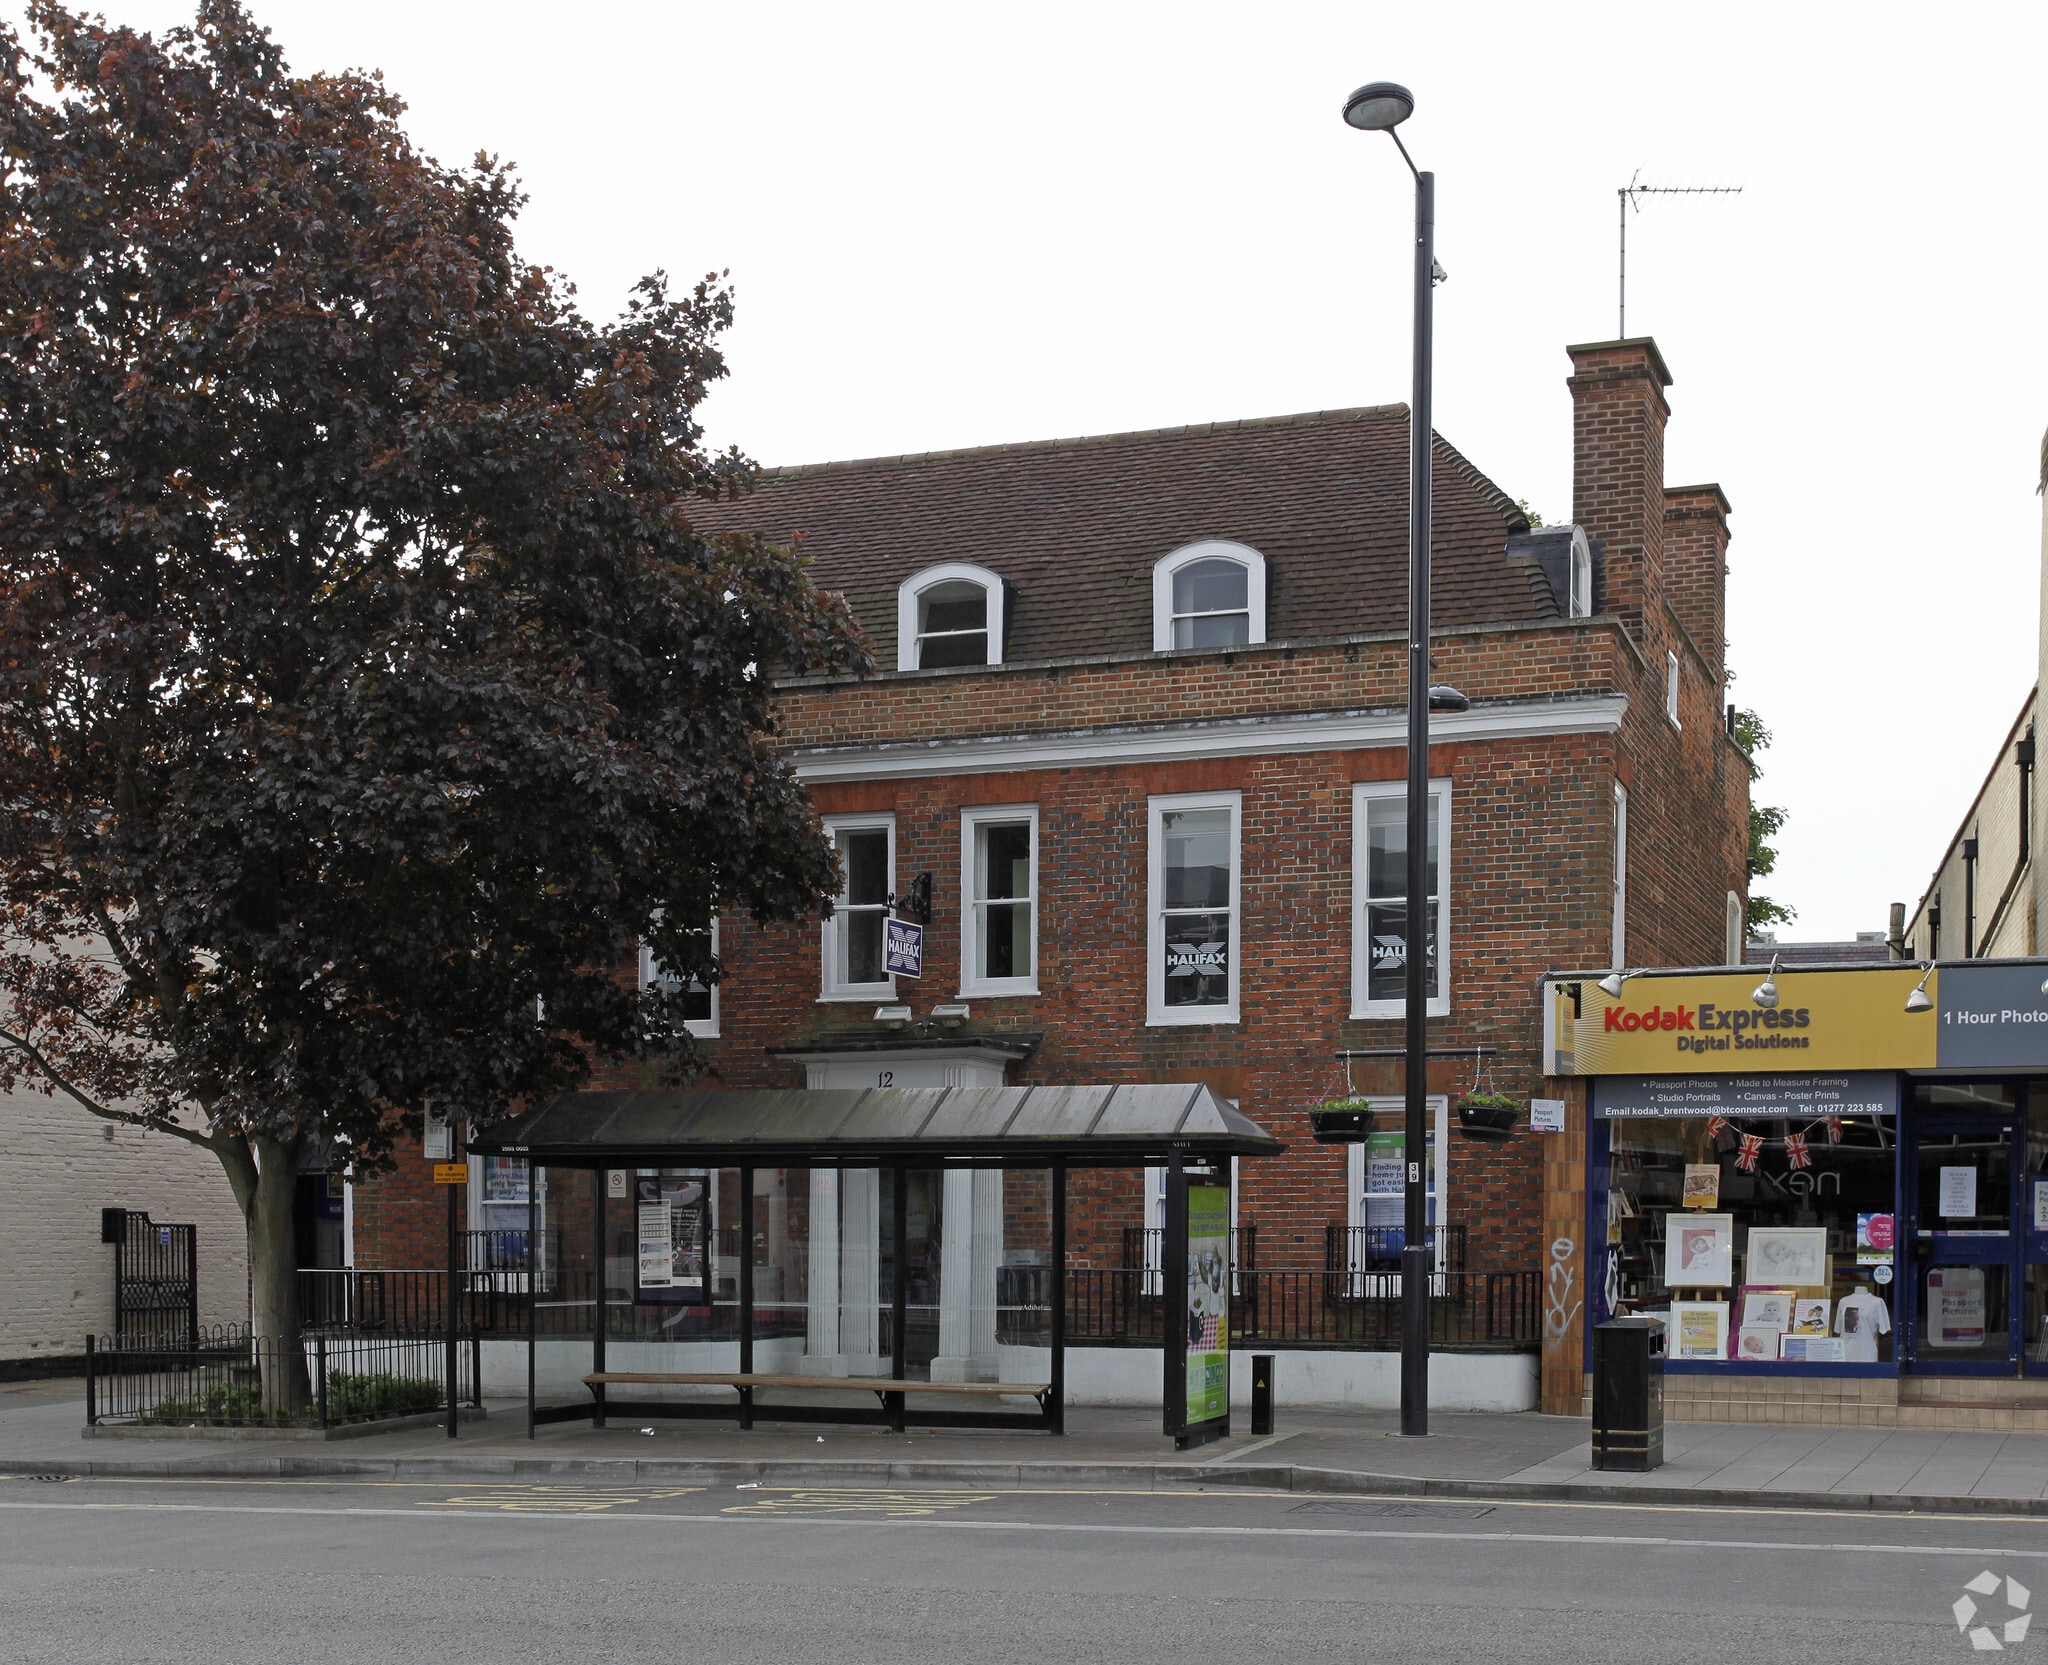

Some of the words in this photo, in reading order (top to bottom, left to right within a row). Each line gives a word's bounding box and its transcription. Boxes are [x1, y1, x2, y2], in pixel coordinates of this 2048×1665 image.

[888, 939, 919, 958] HALIFAX
[1373, 946, 1434, 958] HALIX
[1167, 953, 1226, 965] HALIFAX
[1605, 1005, 1695, 1031] Kodak
[1699, 1004, 1810, 1034] Express
[1944, 1012, 1951, 1024] 1
[1958, 1011, 1996, 1024] Hour
[2002, 1010, 2048, 1023] Photo
[1678, 1035, 1730, 1053] Digital
[1735, 1034, 1810, 1049] Solutions
[878, 1072, 893, 1088] 12
[1650, 1081, 1686, 1090] Passport
[1773, 1079, 1810, 1087] Measure
[1813, 1078, 1848, 1087] Framing
[1686, 1093, 1720, 1101] Portraits
[1785, 1092, 1812, 1100] Poster
[1815, 1091, 1840, 1099] Prints
[1605, 1108, 1630, 1116] Email
[1632, 1105, 1788, 1117] kodak_brentwood@btconnect.com
[1799, 1104, 1814, 1112] Tel:
[1818, 1104, 1844, 1112] 01277
[1847, 1104, 1864, 1112] 223
[1866, 1104, 1882, 1112] 585
[1942, 1298, 1982, 1307] Passport
[414, 1486, 707, 1511] STOP
[720, 1493, 998, 1515] BUS
